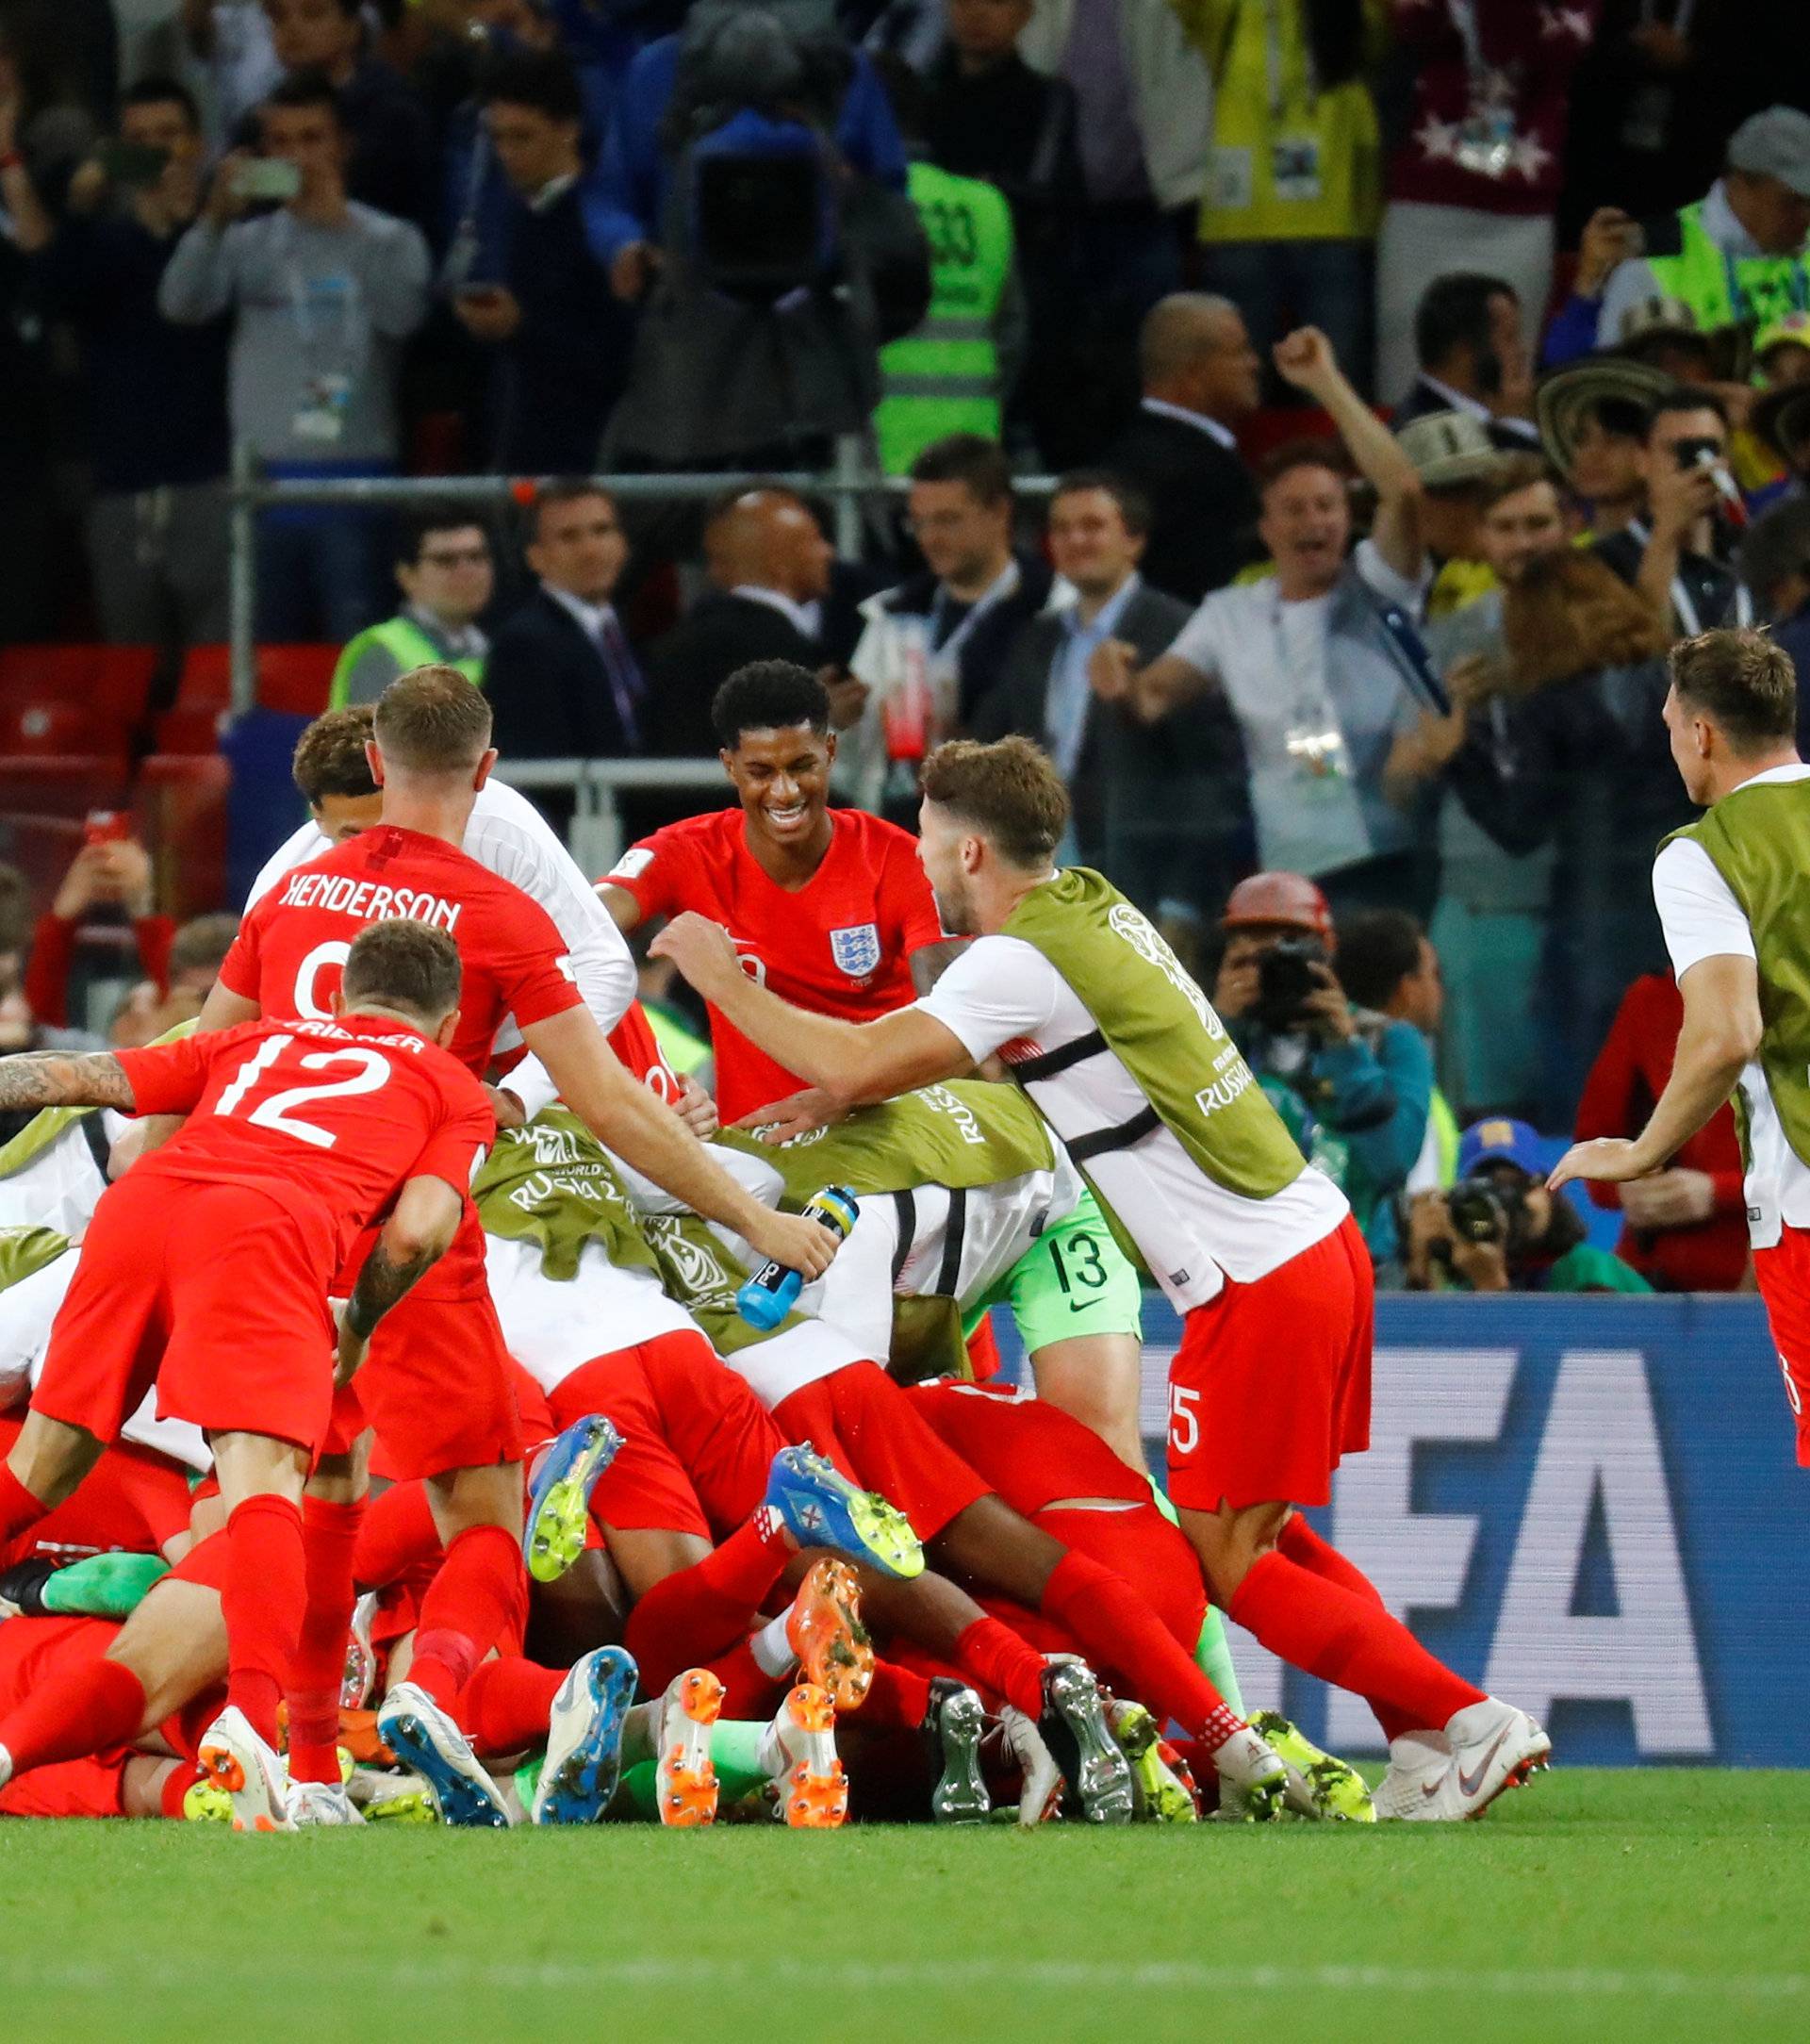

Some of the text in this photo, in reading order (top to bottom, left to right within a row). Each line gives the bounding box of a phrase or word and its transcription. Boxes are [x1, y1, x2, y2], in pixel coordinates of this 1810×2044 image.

[279, 874, 461, 933] HENDERSON
[214, 1033, 391, 1148] 12
[1048, 1232, 1108, 1294] 13
[1021, 1344, 1716, 1754] FA
